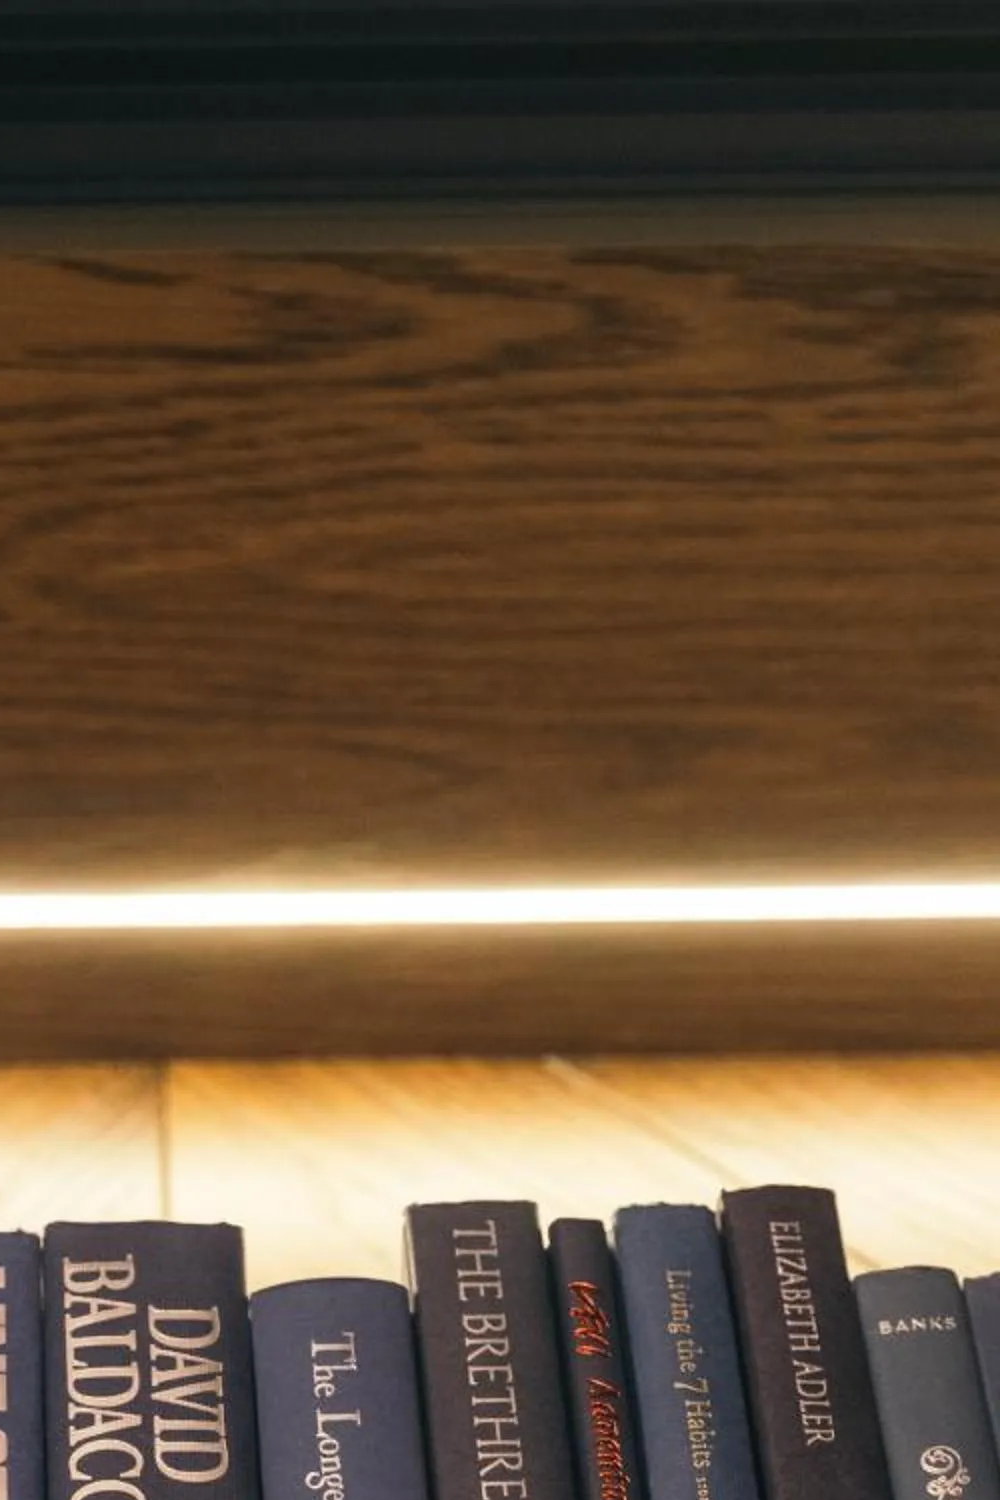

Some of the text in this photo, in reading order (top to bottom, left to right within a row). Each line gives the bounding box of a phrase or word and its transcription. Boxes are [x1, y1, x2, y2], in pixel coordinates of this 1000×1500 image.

[452, 1220, 503, 1304] THE
[878, 1316, 957, 1334] BANKS
[147, 1304, 230, 1484] DAVID
[311, 1332, 357, 1398] The
[665, 1270, 715, 1469] Living the 7 Habits
[769, 1220, 836, 1447] ELIZABETH ADLER
